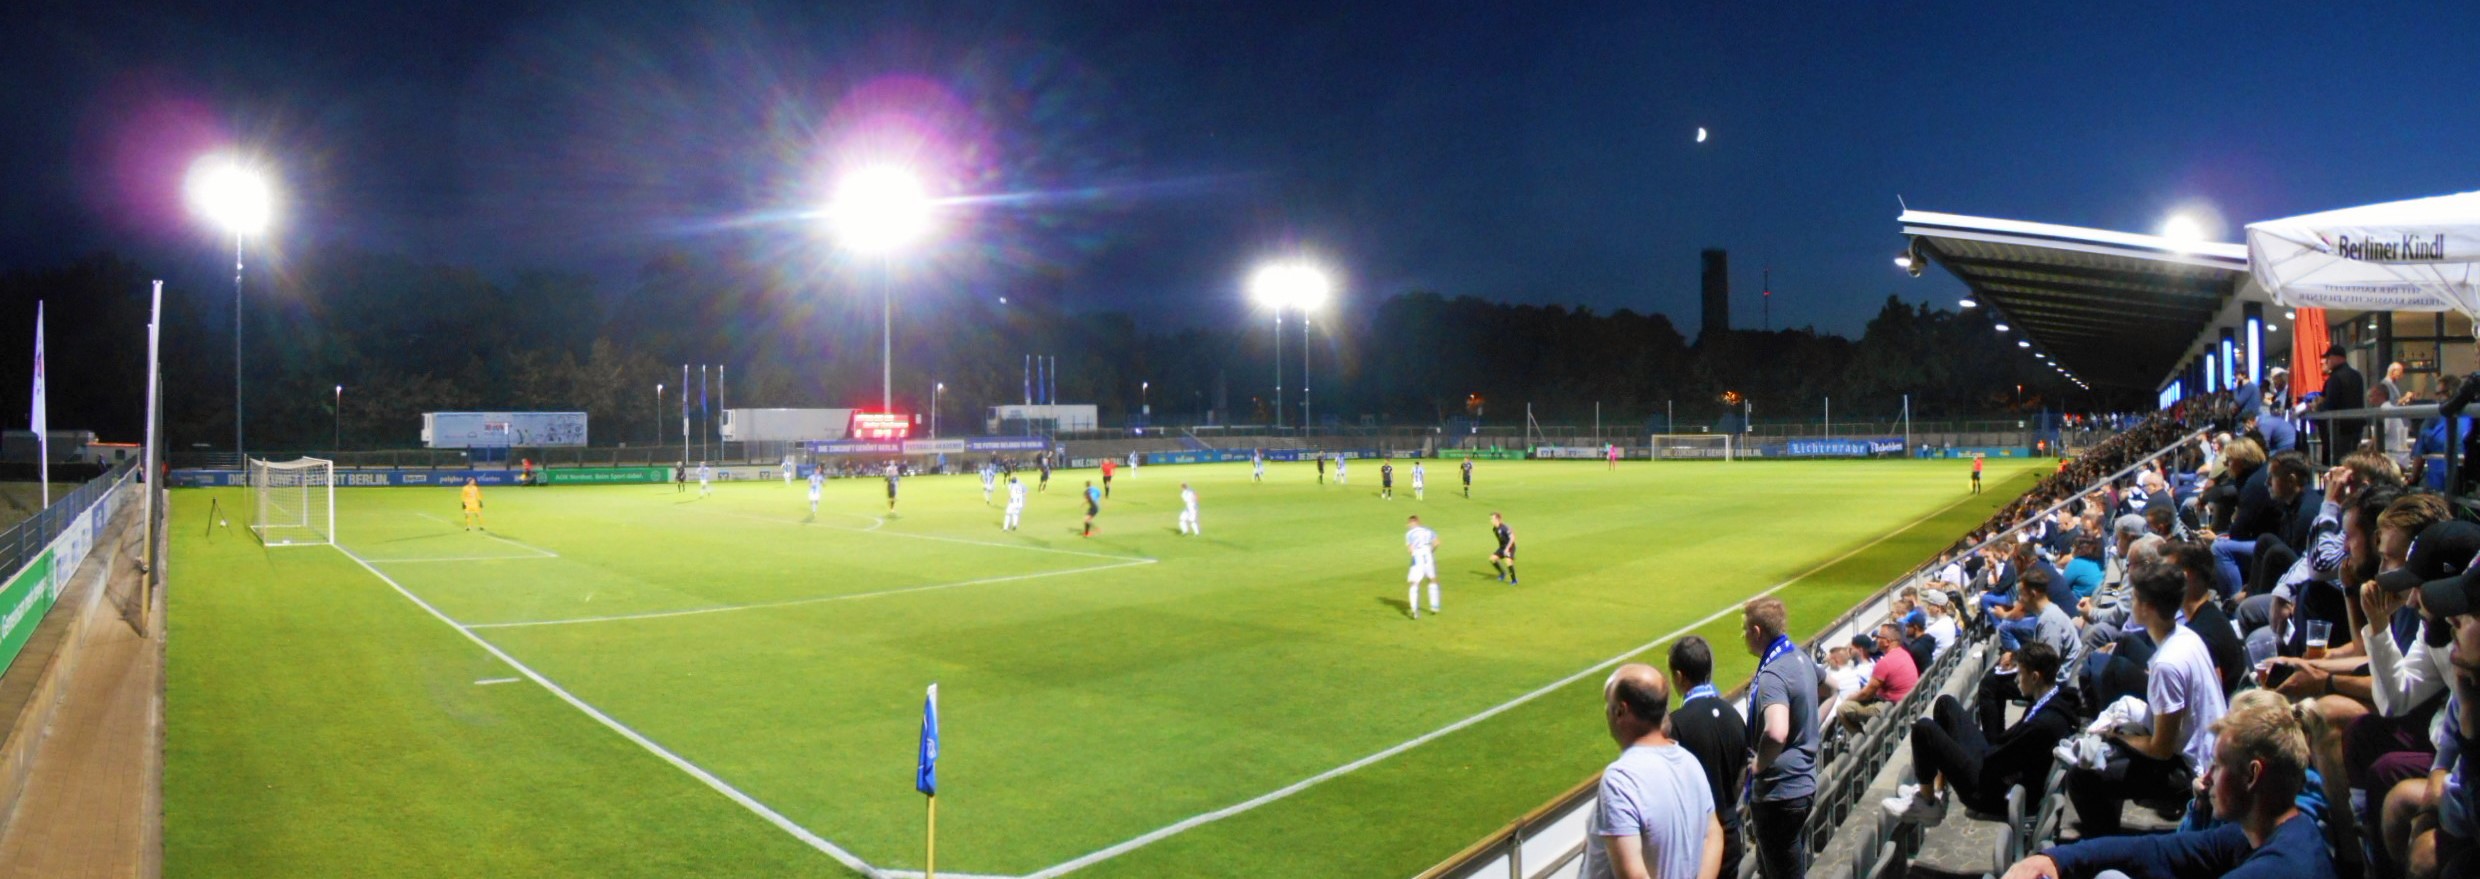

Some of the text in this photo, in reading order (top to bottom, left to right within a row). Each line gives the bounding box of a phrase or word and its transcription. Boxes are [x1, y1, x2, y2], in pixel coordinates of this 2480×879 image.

[2338, 233, 2445, 261] Berliner Kindl
[1792, 441, 1865, 454] Lichtenrade
[228, 473, 246, 485] DIE
[348, 473, 390, 485] BERLIN.
[610, 472, 625, 481] Sport
